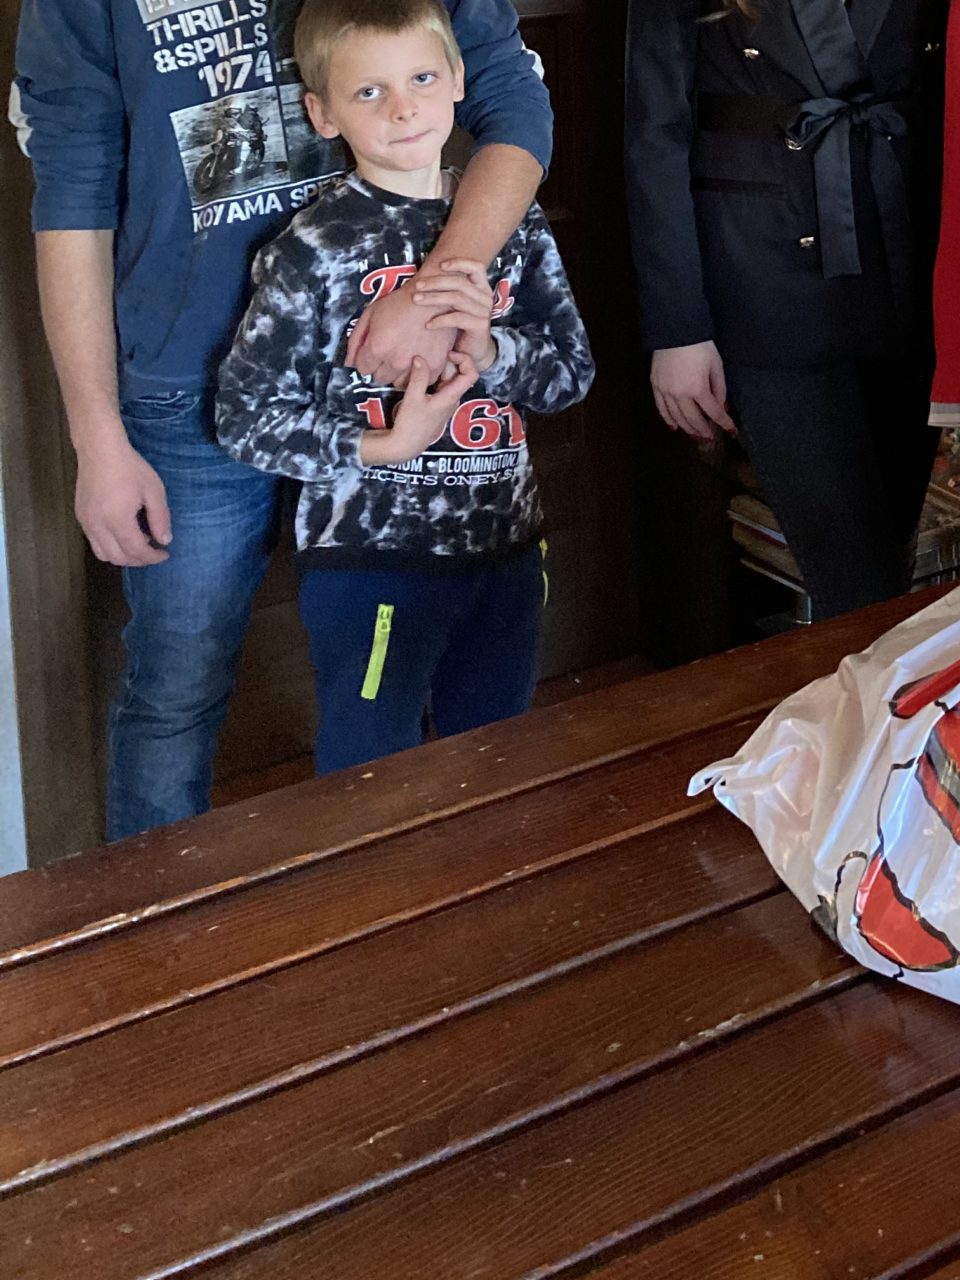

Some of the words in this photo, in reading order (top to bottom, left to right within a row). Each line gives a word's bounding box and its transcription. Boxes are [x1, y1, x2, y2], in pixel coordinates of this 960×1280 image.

[153, 22, 269, 73] &SPILLS
[198, 49, 274, 98] 1974
[192, 192, 284, 233] KOYAMA
[355, 397, 527, 450] 161
